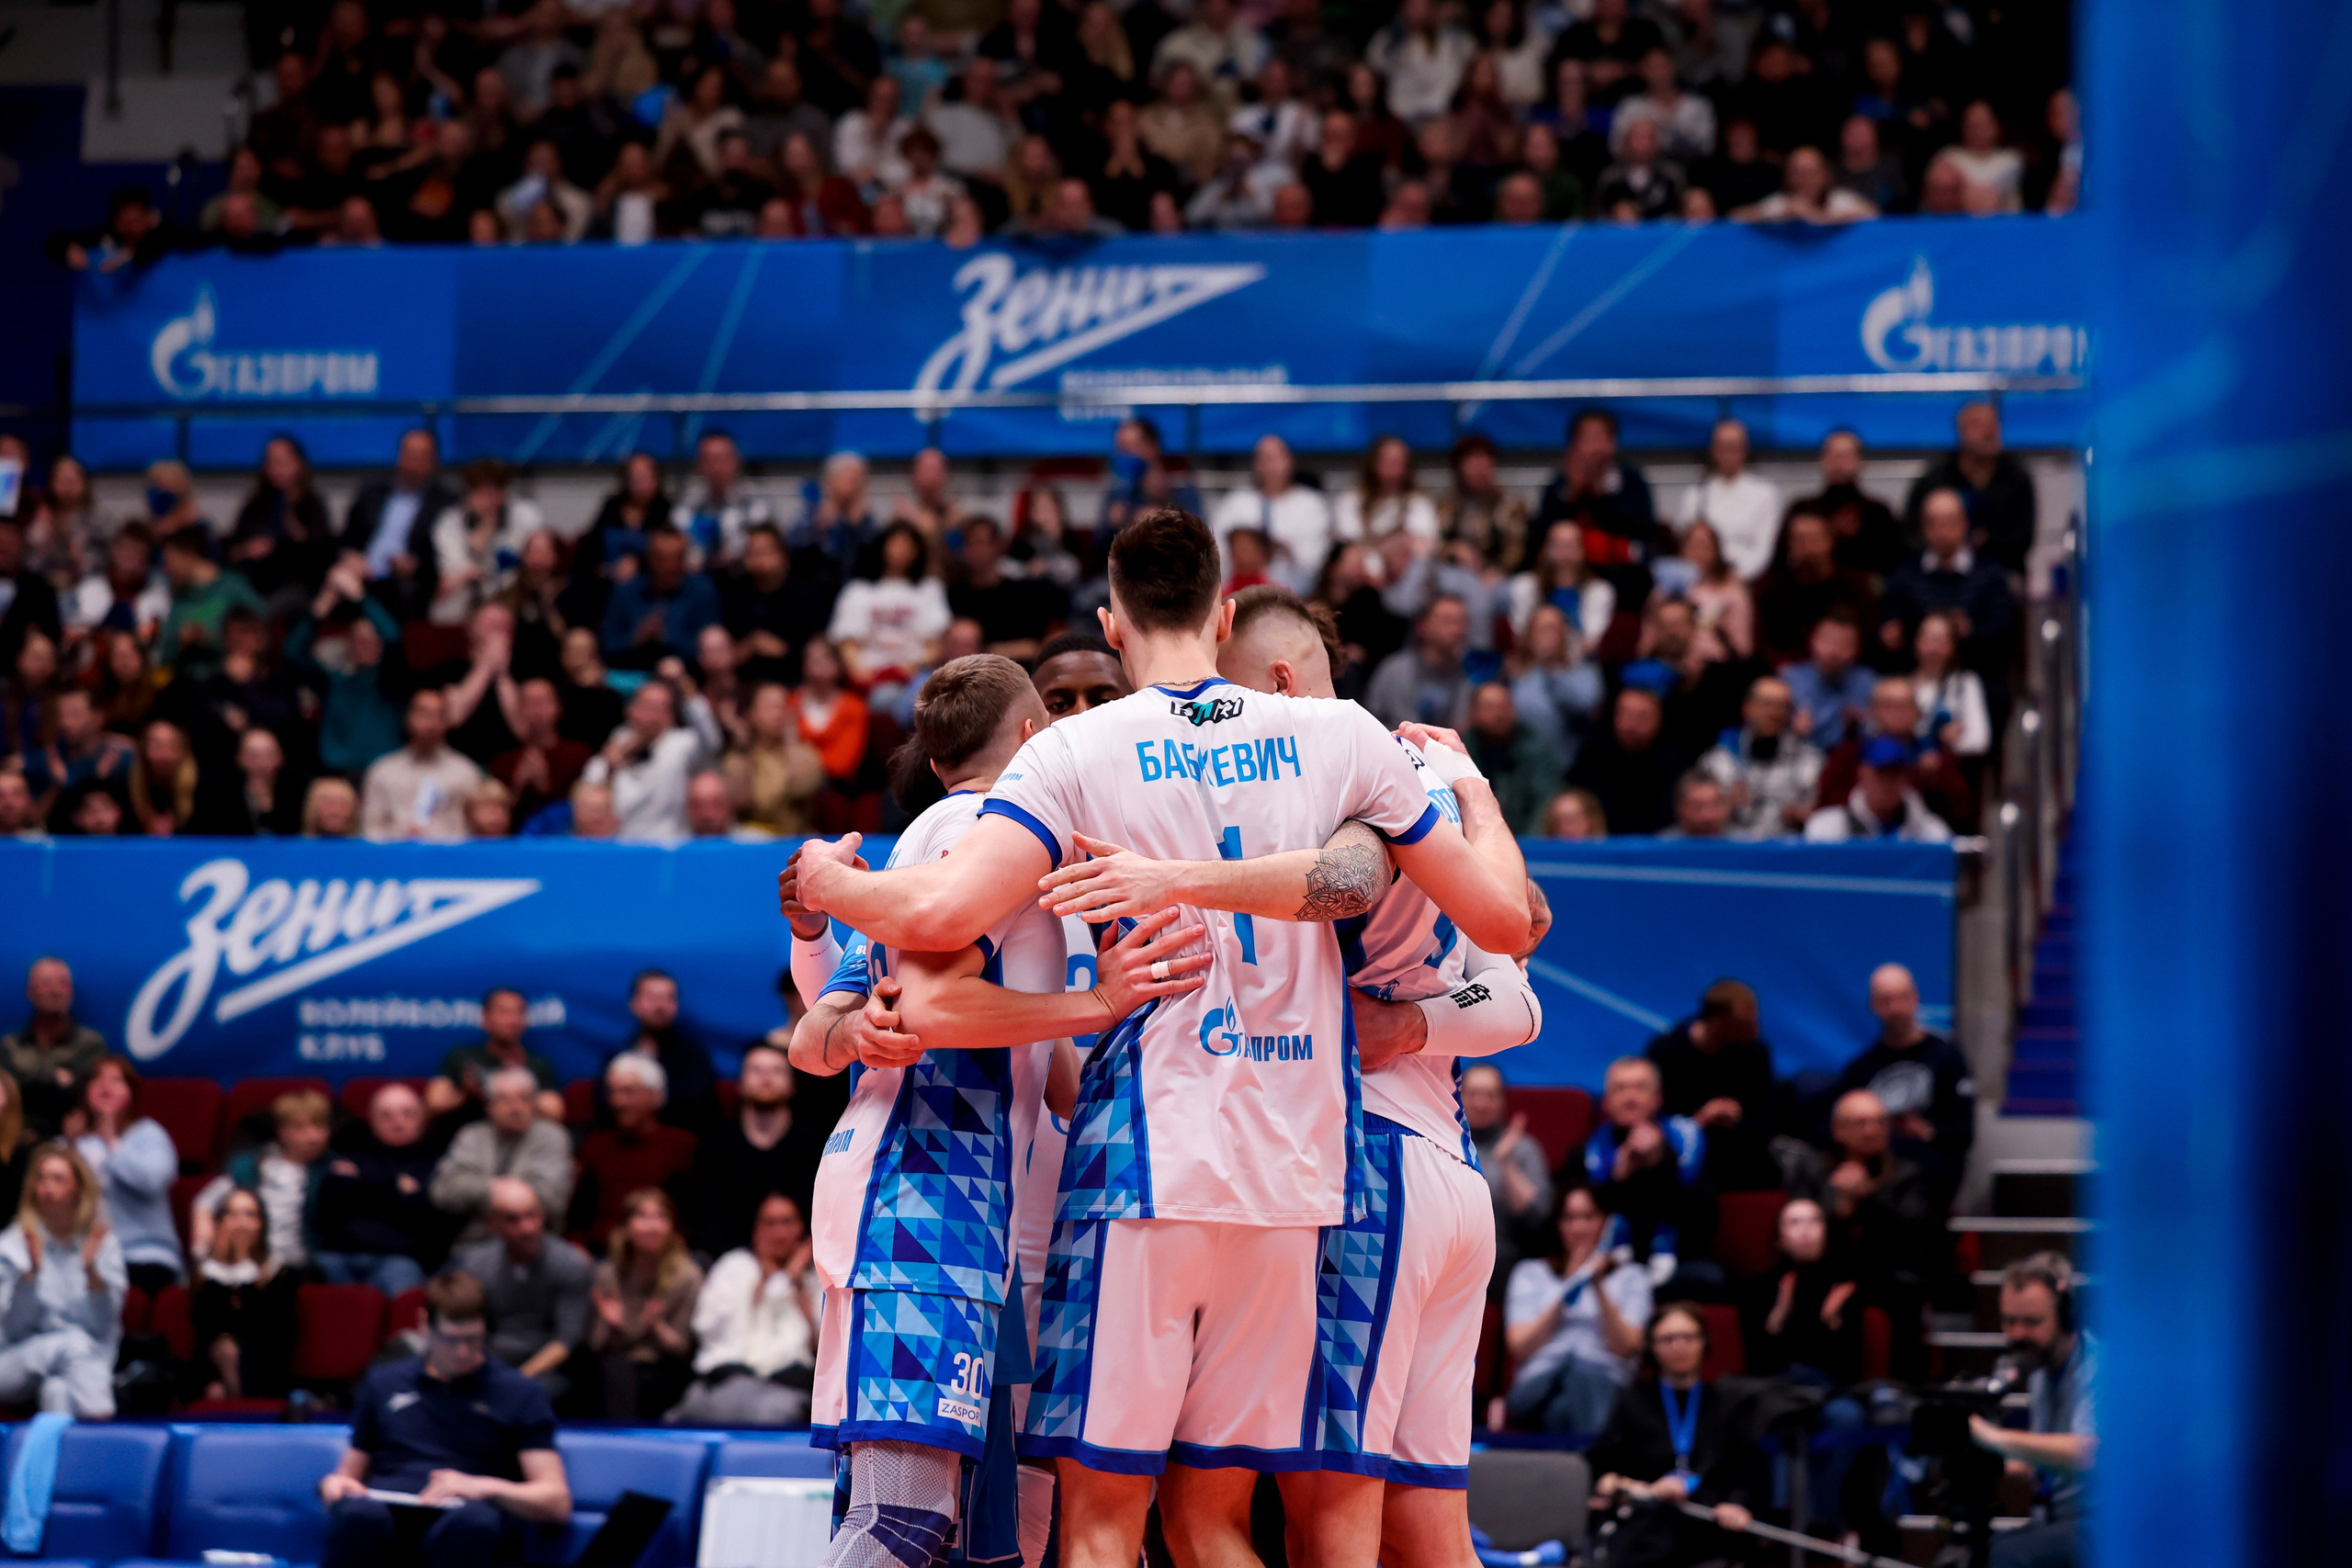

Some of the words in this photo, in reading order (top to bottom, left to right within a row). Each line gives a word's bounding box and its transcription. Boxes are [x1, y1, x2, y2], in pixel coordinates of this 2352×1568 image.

[125, 857, 542, 1061] Зенит
[299, 1033, 386, 1061] КЛУБ
[1237, 1032, 1313, 1062] ГАПРОМ
[951, 1351, 984, 1400] 30
